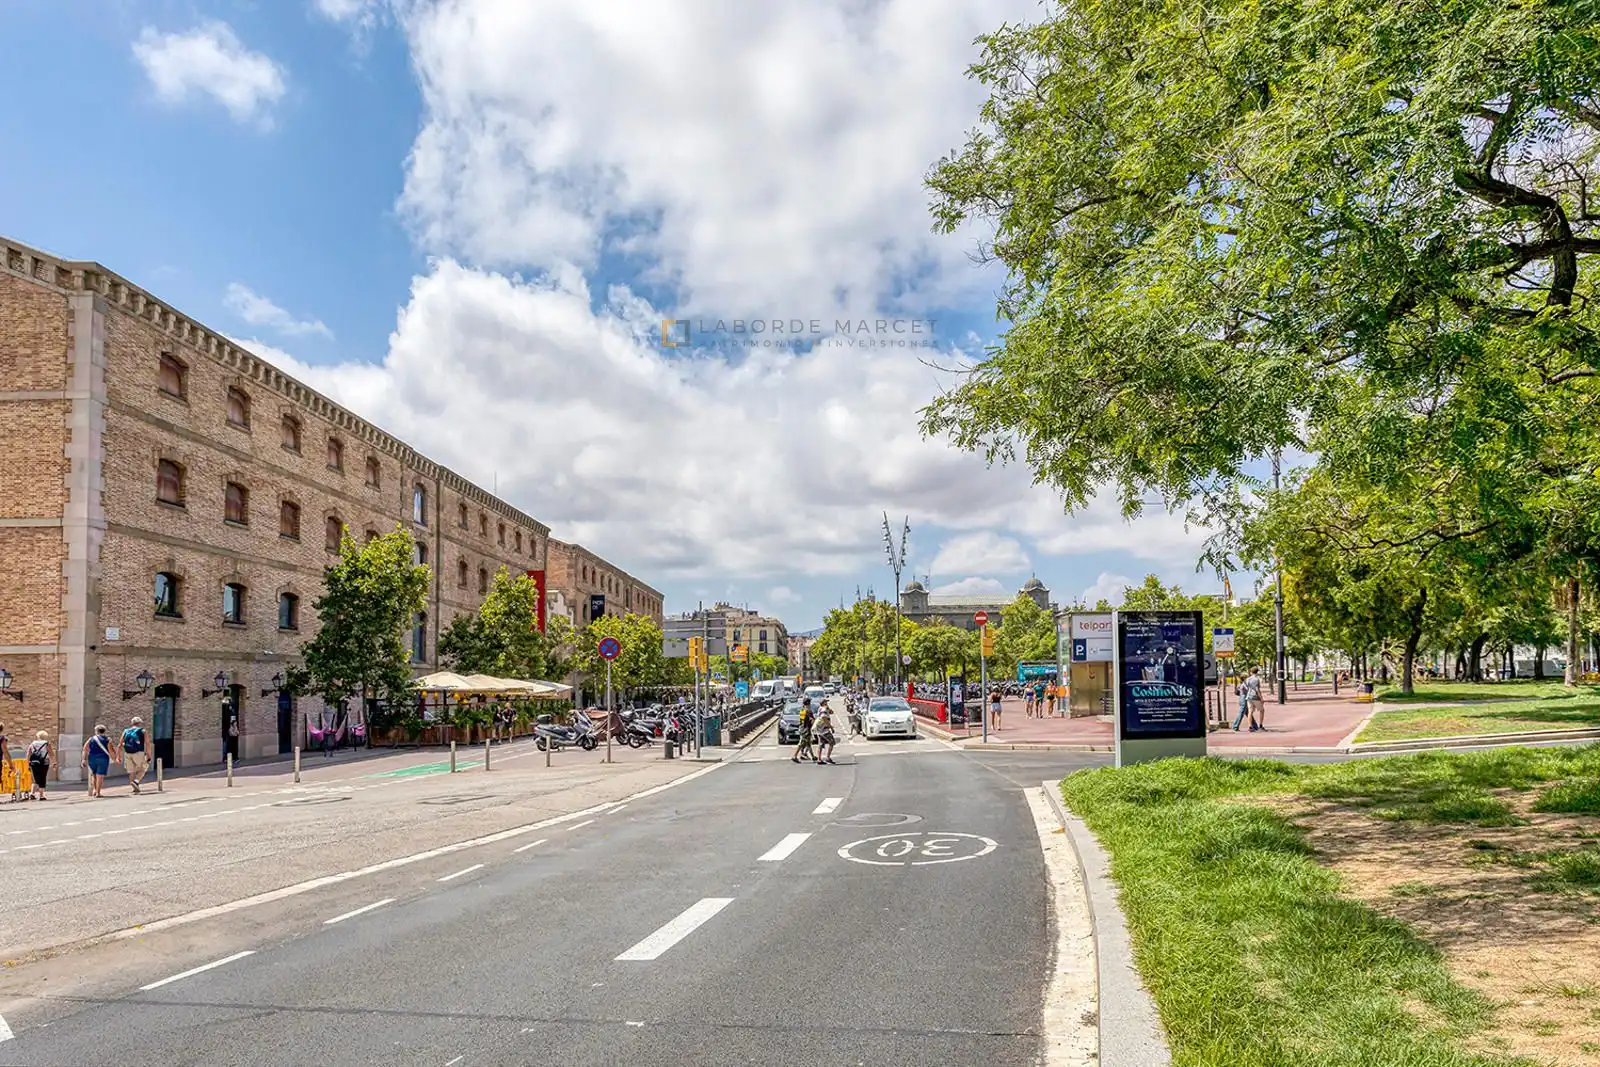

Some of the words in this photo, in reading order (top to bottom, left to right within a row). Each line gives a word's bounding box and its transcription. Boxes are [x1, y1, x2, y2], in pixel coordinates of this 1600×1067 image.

[1079, 621, 1113, 631] telpar
[1132, 685, 1193, 697] CosmoNits
[876, 839, 960, 857] 30
